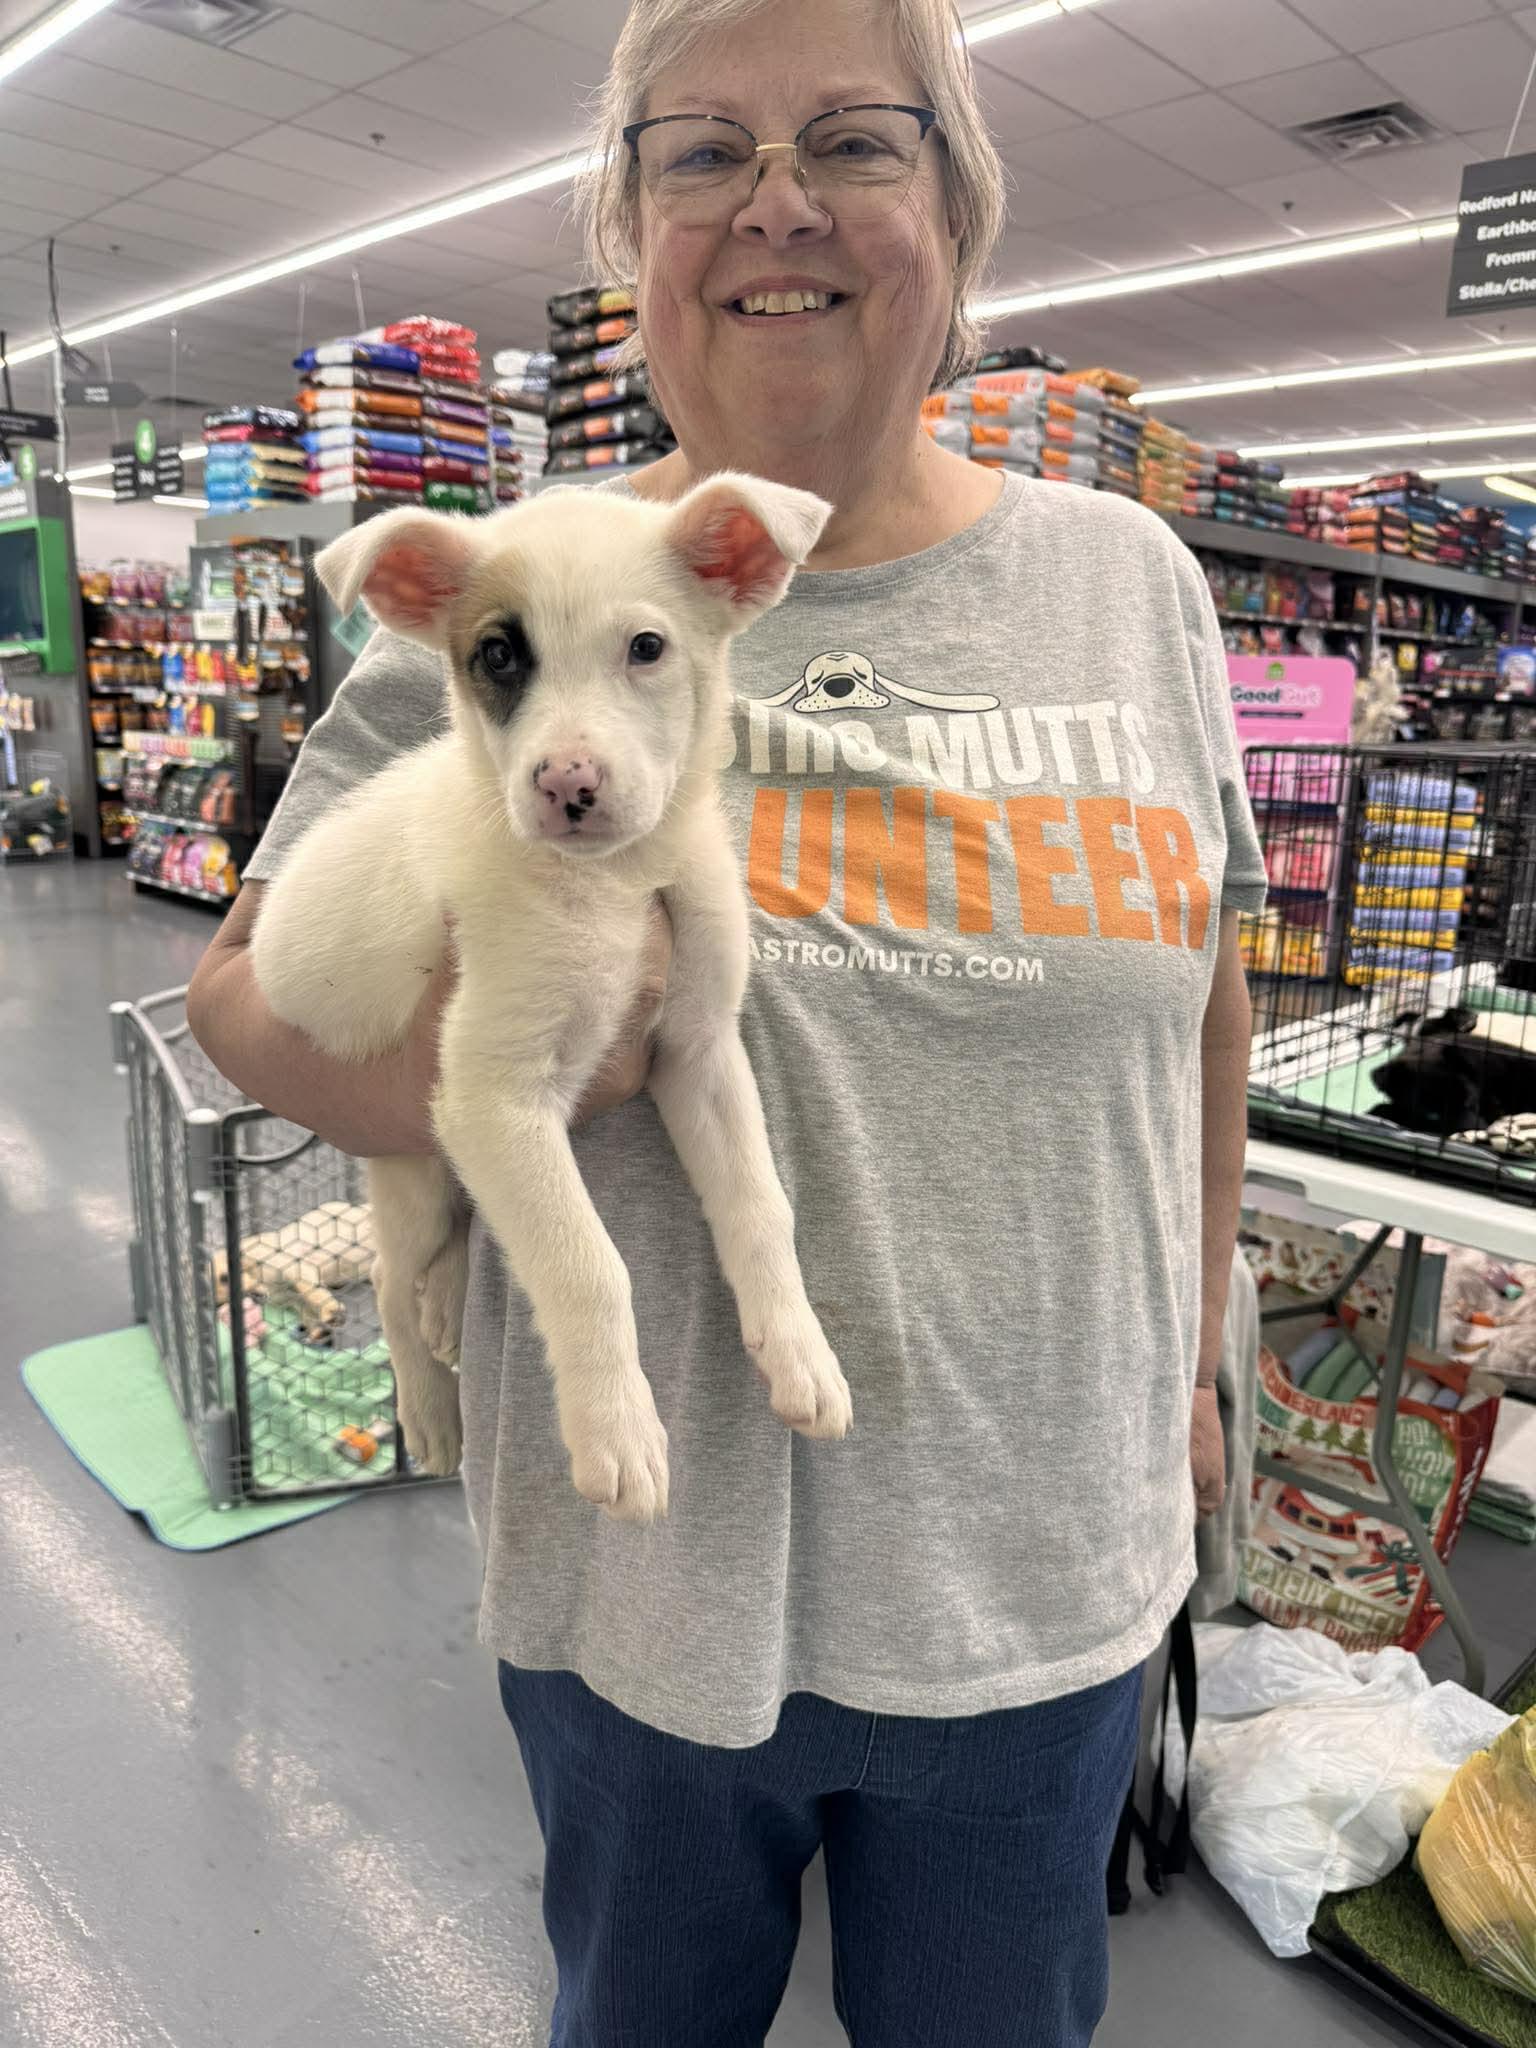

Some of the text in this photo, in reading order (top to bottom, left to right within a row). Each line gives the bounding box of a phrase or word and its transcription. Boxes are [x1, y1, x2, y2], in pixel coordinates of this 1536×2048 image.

[1459, 191, 1519, 215] Redford
[904, 700, 1155, 794] MUTTS
[1246, 1552, 1330, 1609] JOYEUX
[1253, 1587, 1302, 1630] CALM
